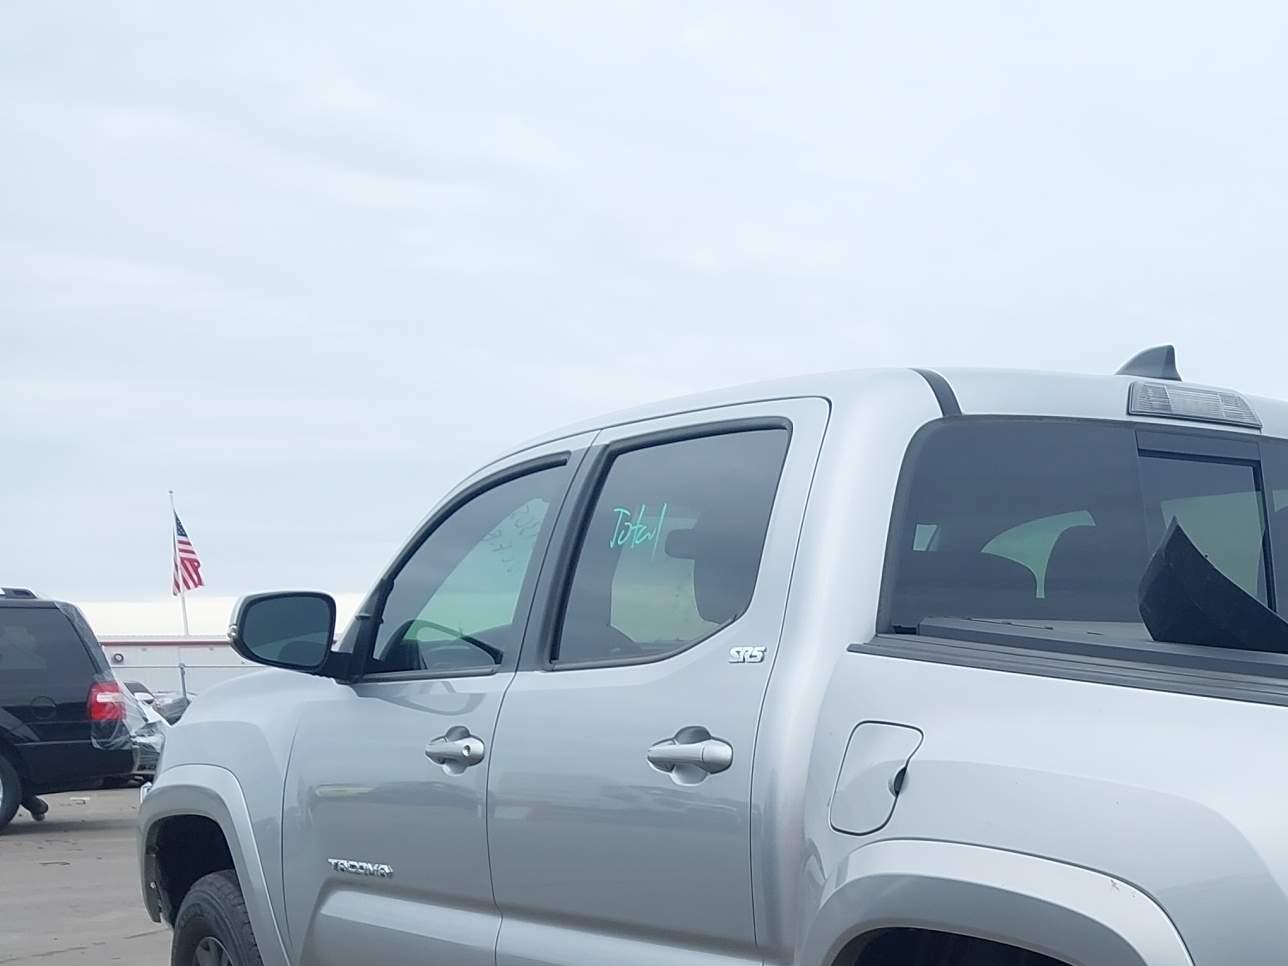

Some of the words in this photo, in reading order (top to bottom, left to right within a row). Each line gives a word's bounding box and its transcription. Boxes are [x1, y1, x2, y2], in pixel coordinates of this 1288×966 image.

[609, 503, 668, 558] Total
[729, 646, 766, 663] SR5
[327, 858, 394, 877] TACOMA
